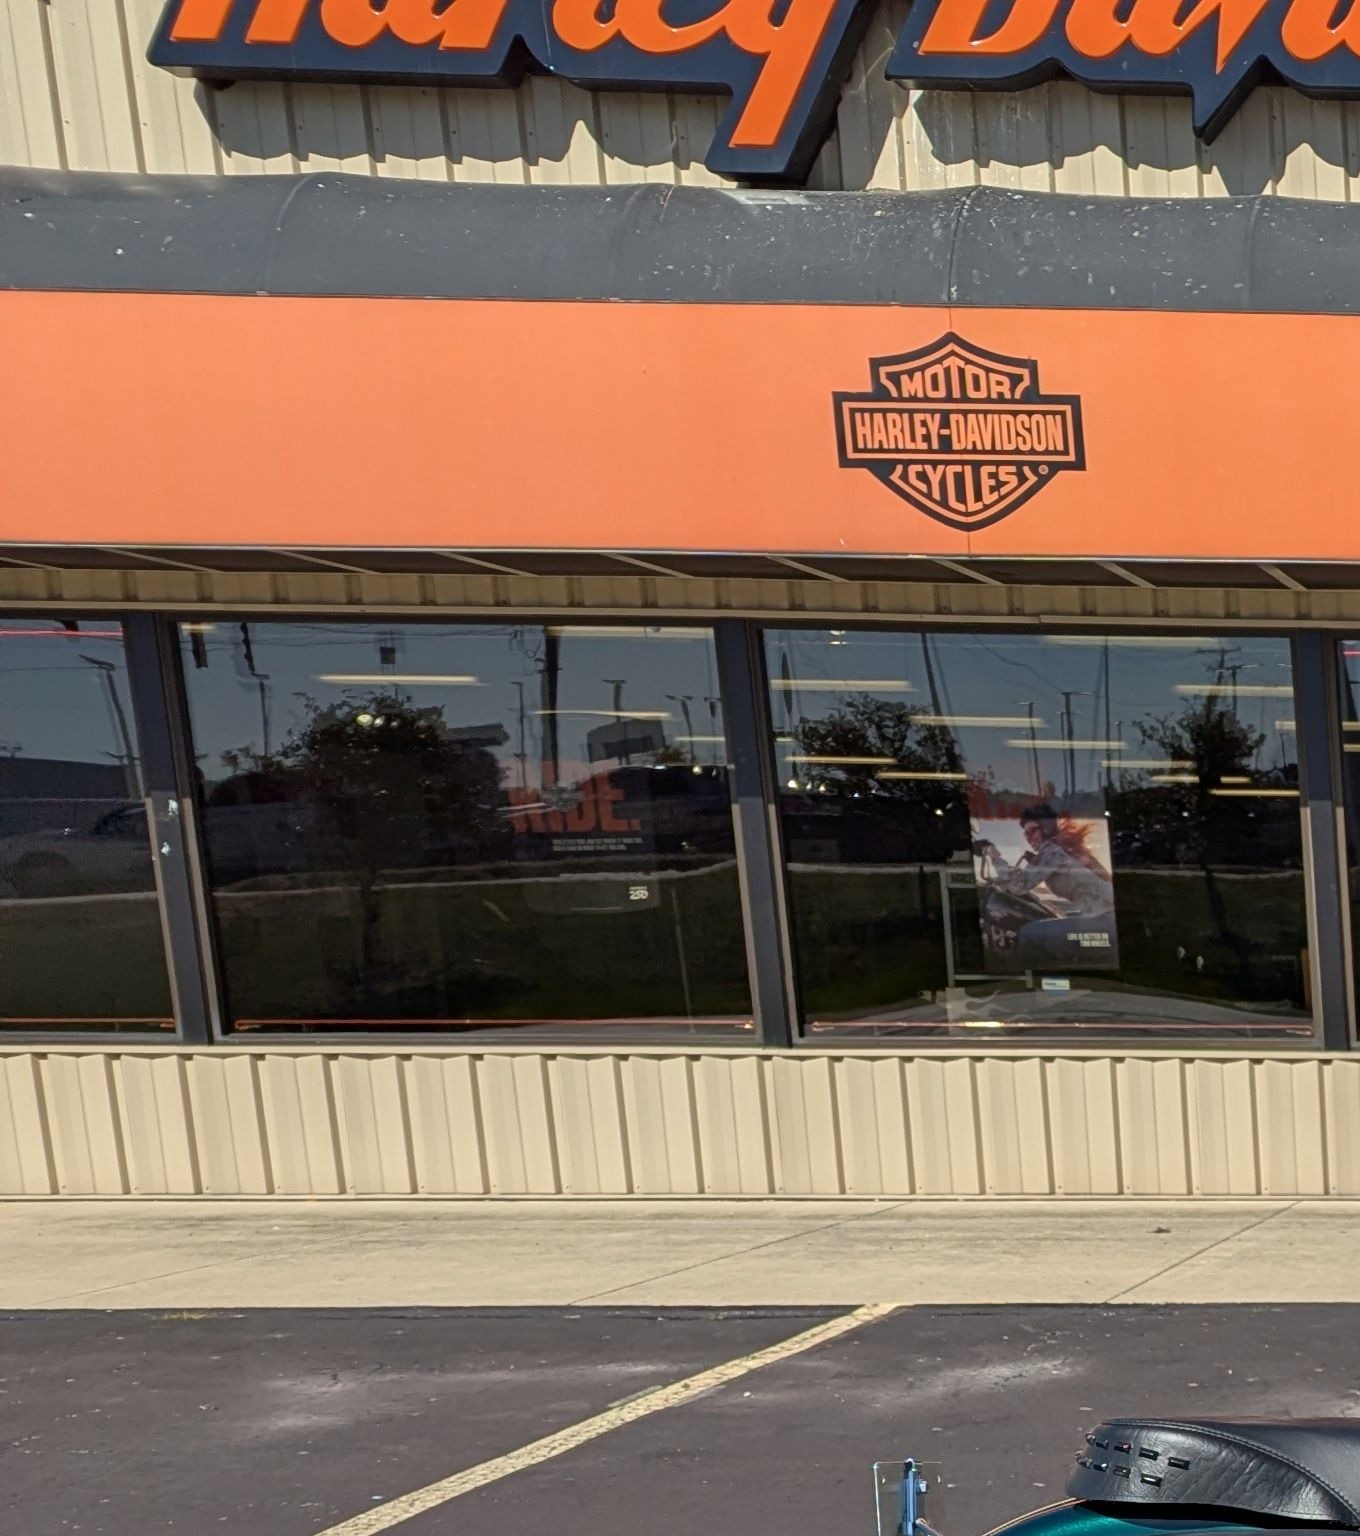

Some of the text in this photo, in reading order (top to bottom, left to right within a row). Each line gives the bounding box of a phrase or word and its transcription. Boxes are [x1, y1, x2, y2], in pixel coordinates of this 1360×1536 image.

[900, 355, 1012, 399] MOTOR
[853, 411, 1065, 452] HARLEY-DAVIDSON
[907, 464, 1019, 512] CYCLES
